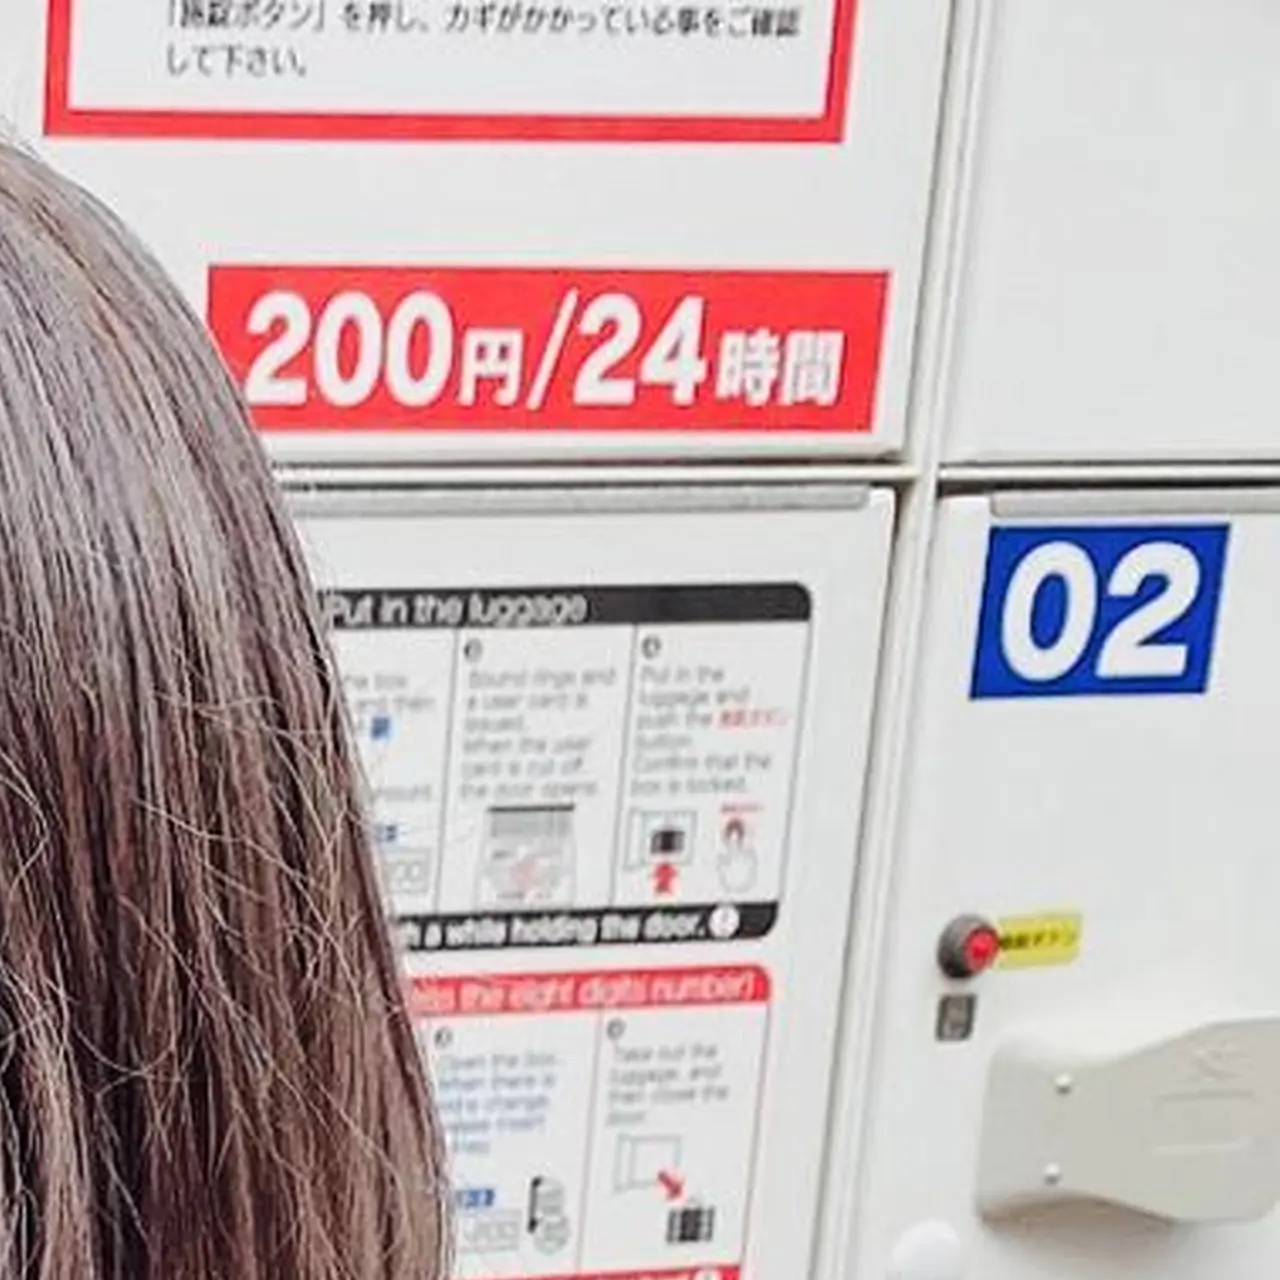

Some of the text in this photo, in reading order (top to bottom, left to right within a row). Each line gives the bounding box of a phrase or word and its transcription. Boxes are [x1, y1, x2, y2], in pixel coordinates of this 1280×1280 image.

[245, 288, 843, 411] 200円/24時間
[1001, 540, 1201, 682] 02
